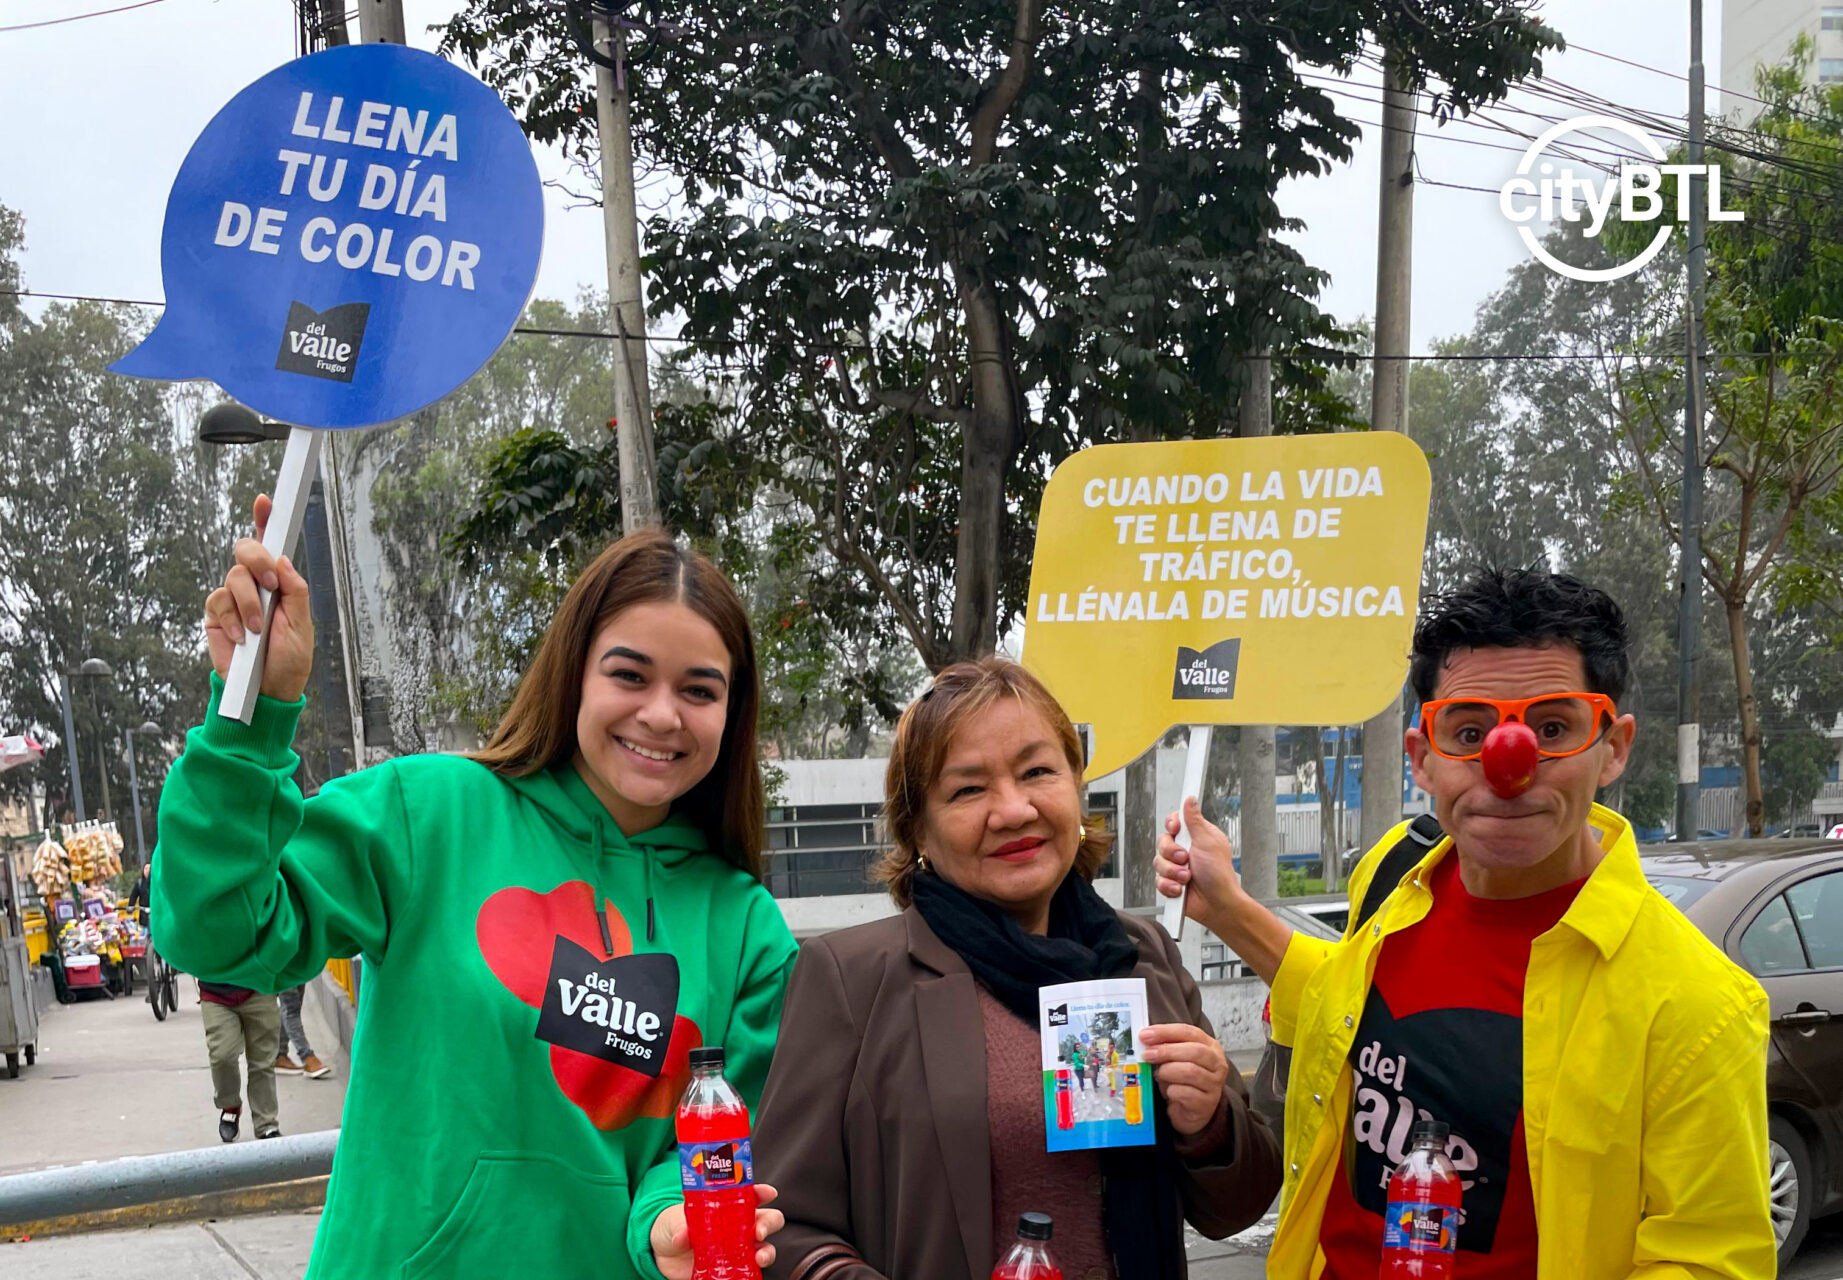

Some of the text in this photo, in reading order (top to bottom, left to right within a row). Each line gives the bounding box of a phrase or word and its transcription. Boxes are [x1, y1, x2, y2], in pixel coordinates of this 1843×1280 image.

[291, 92, 458, 161] LLENA
[278, 149, 447, 222] TU DÍA
[214, 201, 481, 290] DE COLOR
[289, 331, 351, 362] Valle
[306, 322, 326, 336] del
[316, 360, 347, 373] Frugos
[1083, 466, 1383, 507] CUANDO LA VIDA
[1114, 508, 1342, 544] TE LLENA DE
[1139, 545, 1302, 584] TRÁFICO,
[1037, 580, 1404, 622] LLÉNALA DE MÚSICA
[1180, 668, 1230, 685] Valle
[1192, 659, 1207, 669] del
[585, 971, 616, 995] del
[558, 979, 660, 1041] Valle
[605, 1032, 652, 1059] Frugos
[1359, 1041, 1407, 1091] del
[1353, 1069, 1479, 1191] ale
[705, 1159, 732, 1170] Valle
[1413, 1219, 1440, 1230] Valle
